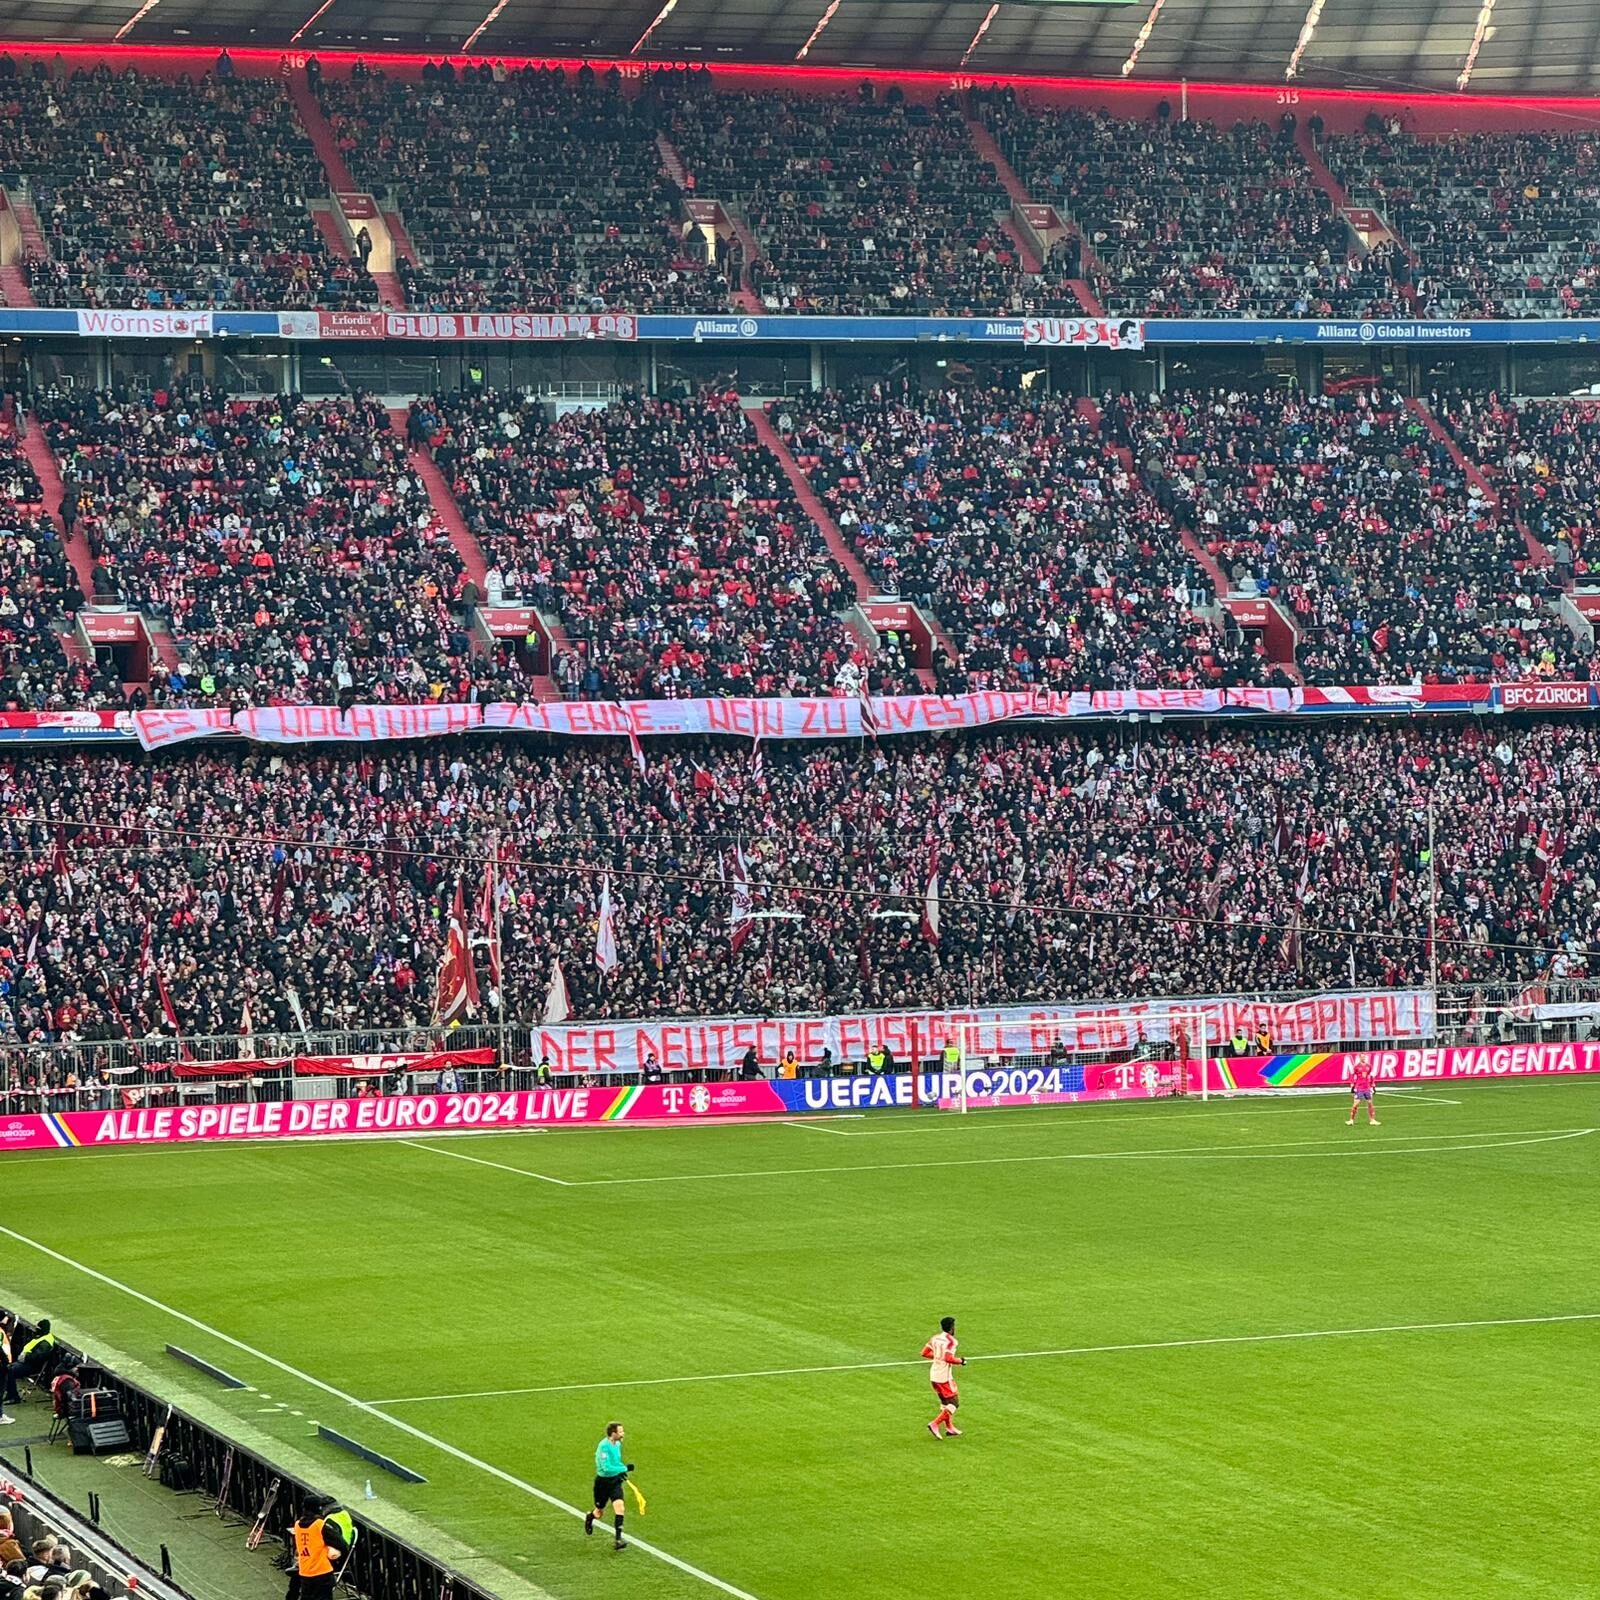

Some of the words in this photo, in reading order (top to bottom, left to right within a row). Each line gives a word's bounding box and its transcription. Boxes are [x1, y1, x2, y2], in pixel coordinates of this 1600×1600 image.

[289, 55, 305, 68] 16
[950, 78, 972, 89] 314
[1276, 91, 1299, 104] 313
[322, 327, 359, 337] Bavaria
[387, 316, 457, 337] CLUB
[463, 316, 590, 338] LAUSHAM
[597, 317, 633, 338] 98
[695, 321, 737, 334] Allianz
[1025, 319, 1100, 344] SUPS
[1317, 326, 1357, 337] Allianz
[1377, 326, 1415, 337] Global
[1417, 326, 1471, 338] Investors
[1504, 688, 1534, 704] BFC
[1535, 687, 1588, 704] ZÜRICH
[136, 711, 196, 743] ES
[706, 699, 783, 735] NEIN
[800, 702, 848, 734] ZU
[1135, 690, 1205, 708] DER
[541, 1029, 617, 1072] DER
[636, 1021, 826, 1070] DEUTSCHE
[1403, 1049, 1444, 1077] BEI
[1451, 1045, 1577, 1075] MAGENTA
[1583, 1045, 1600, 1069] T
[95, 1109, 173, 1141] ALLE
[179, 1101, 284, 1136] SPIELE
[289, 1101, 350, 1131] DER
[356, 1097, 439, 1128] EURO
[445, 1095, 518, 1124] 2024
[525, 1091, 590, 1121] LIVE
